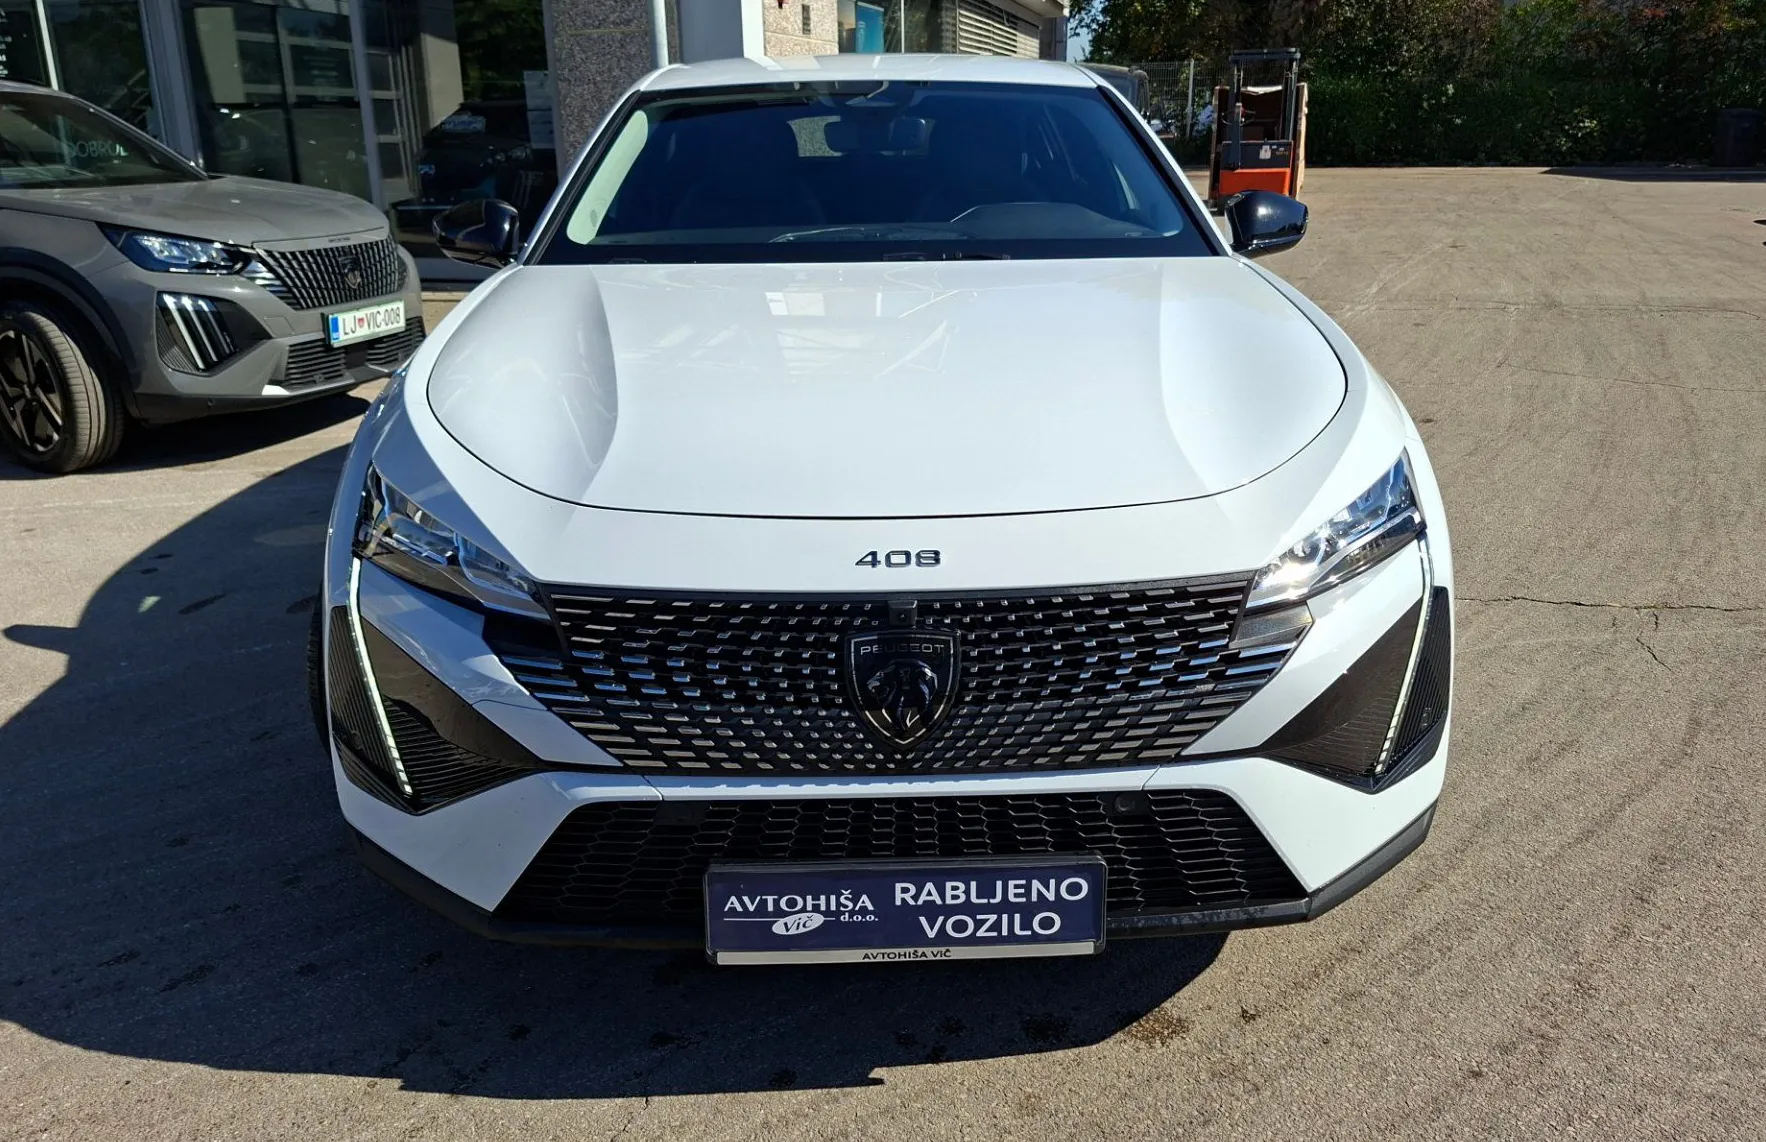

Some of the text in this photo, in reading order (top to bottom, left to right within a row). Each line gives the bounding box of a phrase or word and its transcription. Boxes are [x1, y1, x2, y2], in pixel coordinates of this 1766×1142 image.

[343, 315, 358, 335] LJ
[854, 549, 941, 568] 408
[860, 642, 945, 656] PEUGEOT
[723, 889, 875, 912] AVTOHIŠA
[894, 877, 1089, 906] RABLJENO
[782, 914, 814, 933] Vič
[840, 912, 879, 922] d.o.o.
[918, 911, 1062, 939] VOZILO
[862, 948, 952, 961] AVTOHIŠA VIČ
